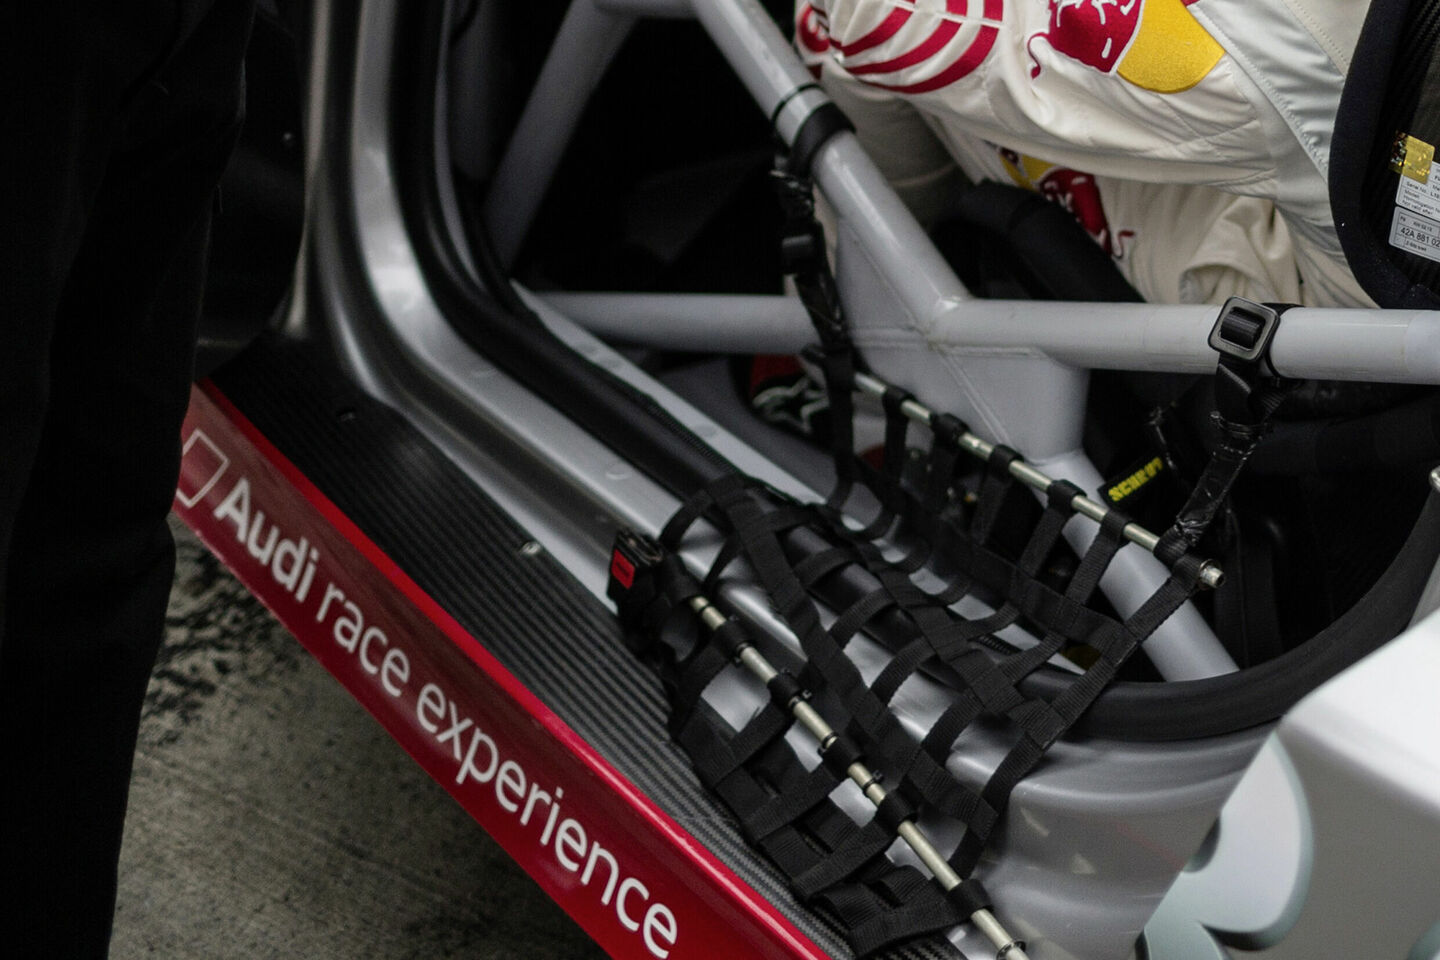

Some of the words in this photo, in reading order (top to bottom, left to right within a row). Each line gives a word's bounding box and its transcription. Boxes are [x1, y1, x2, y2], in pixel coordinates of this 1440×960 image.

[1400, 227, 1415, 238] 42A
[1416, 232, 1430, 243] 881
[214, 477, 320, 602] Audi
[315, 583, 410, 697] race
[415, 683, 678, 960] experience
